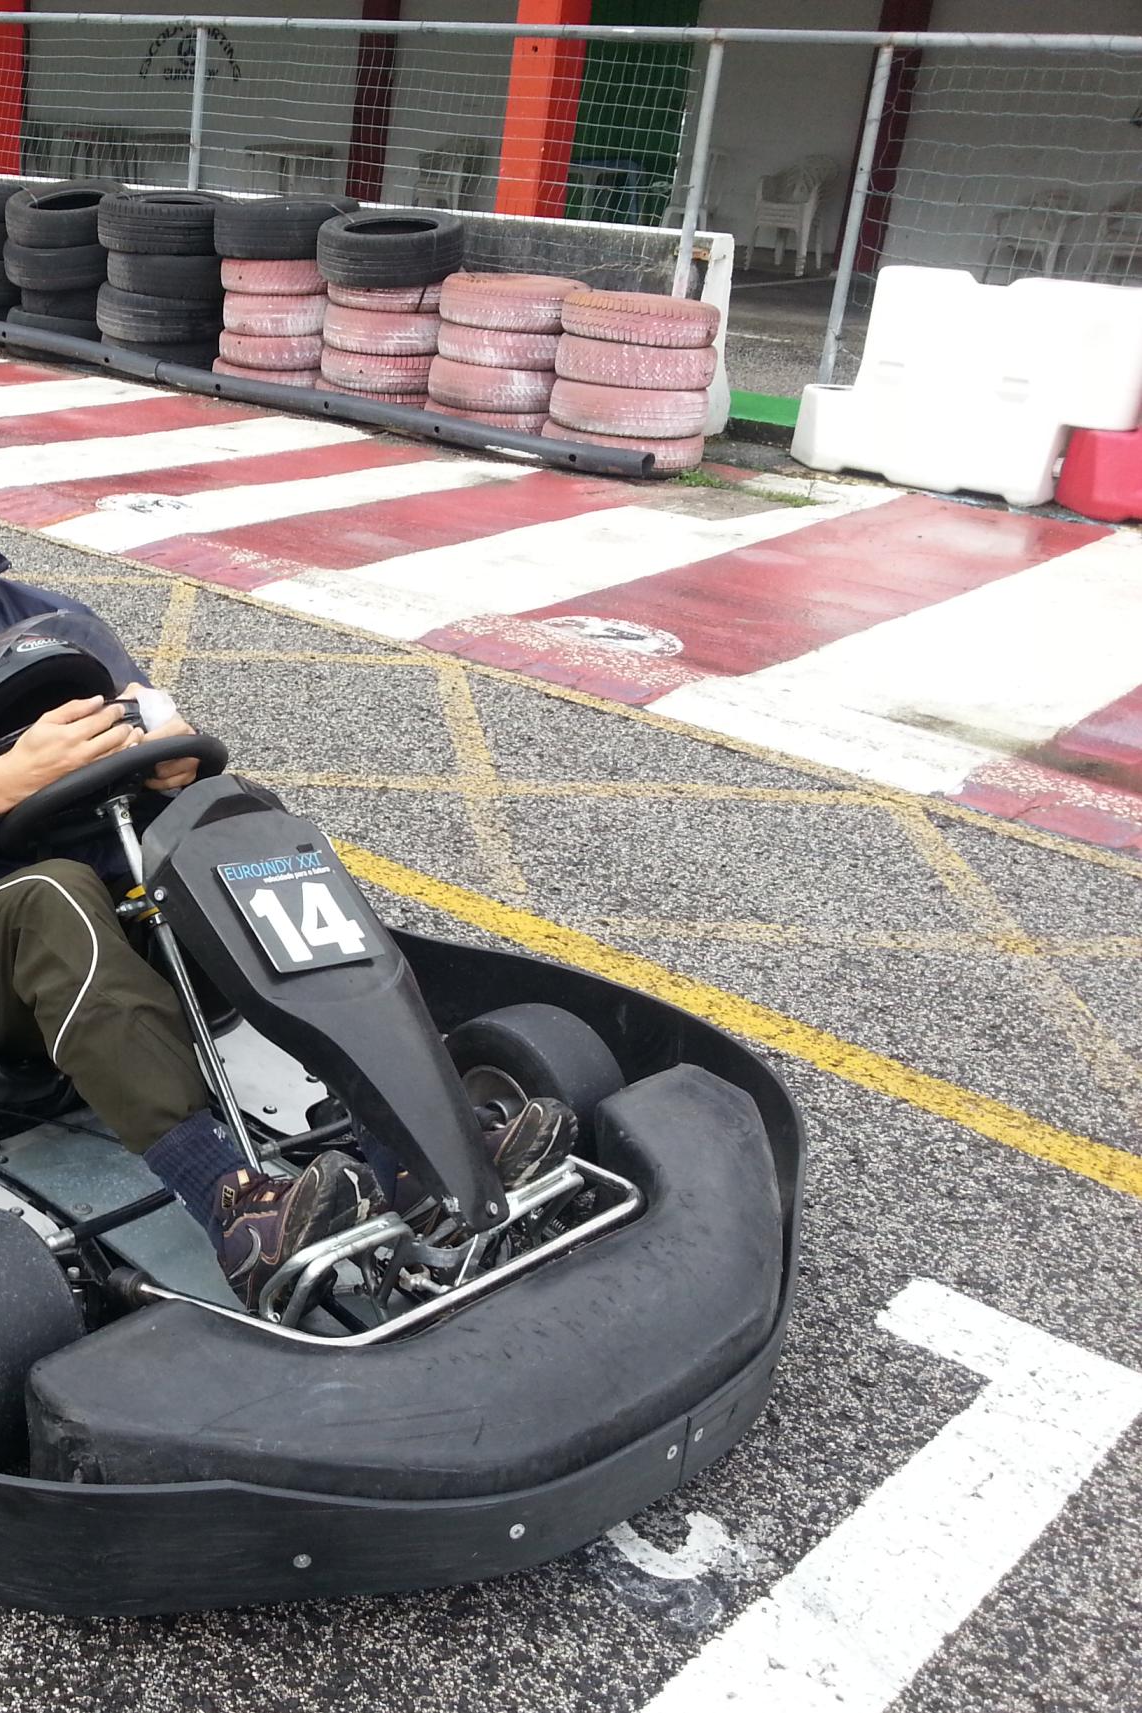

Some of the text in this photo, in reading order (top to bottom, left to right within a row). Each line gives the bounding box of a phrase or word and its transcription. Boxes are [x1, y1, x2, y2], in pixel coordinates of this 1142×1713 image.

[224, 852, 322, 882] EUROINDY XXI
[249, 882, 366, 963] 14
[222, 1186, 235, 1209] NIKE
